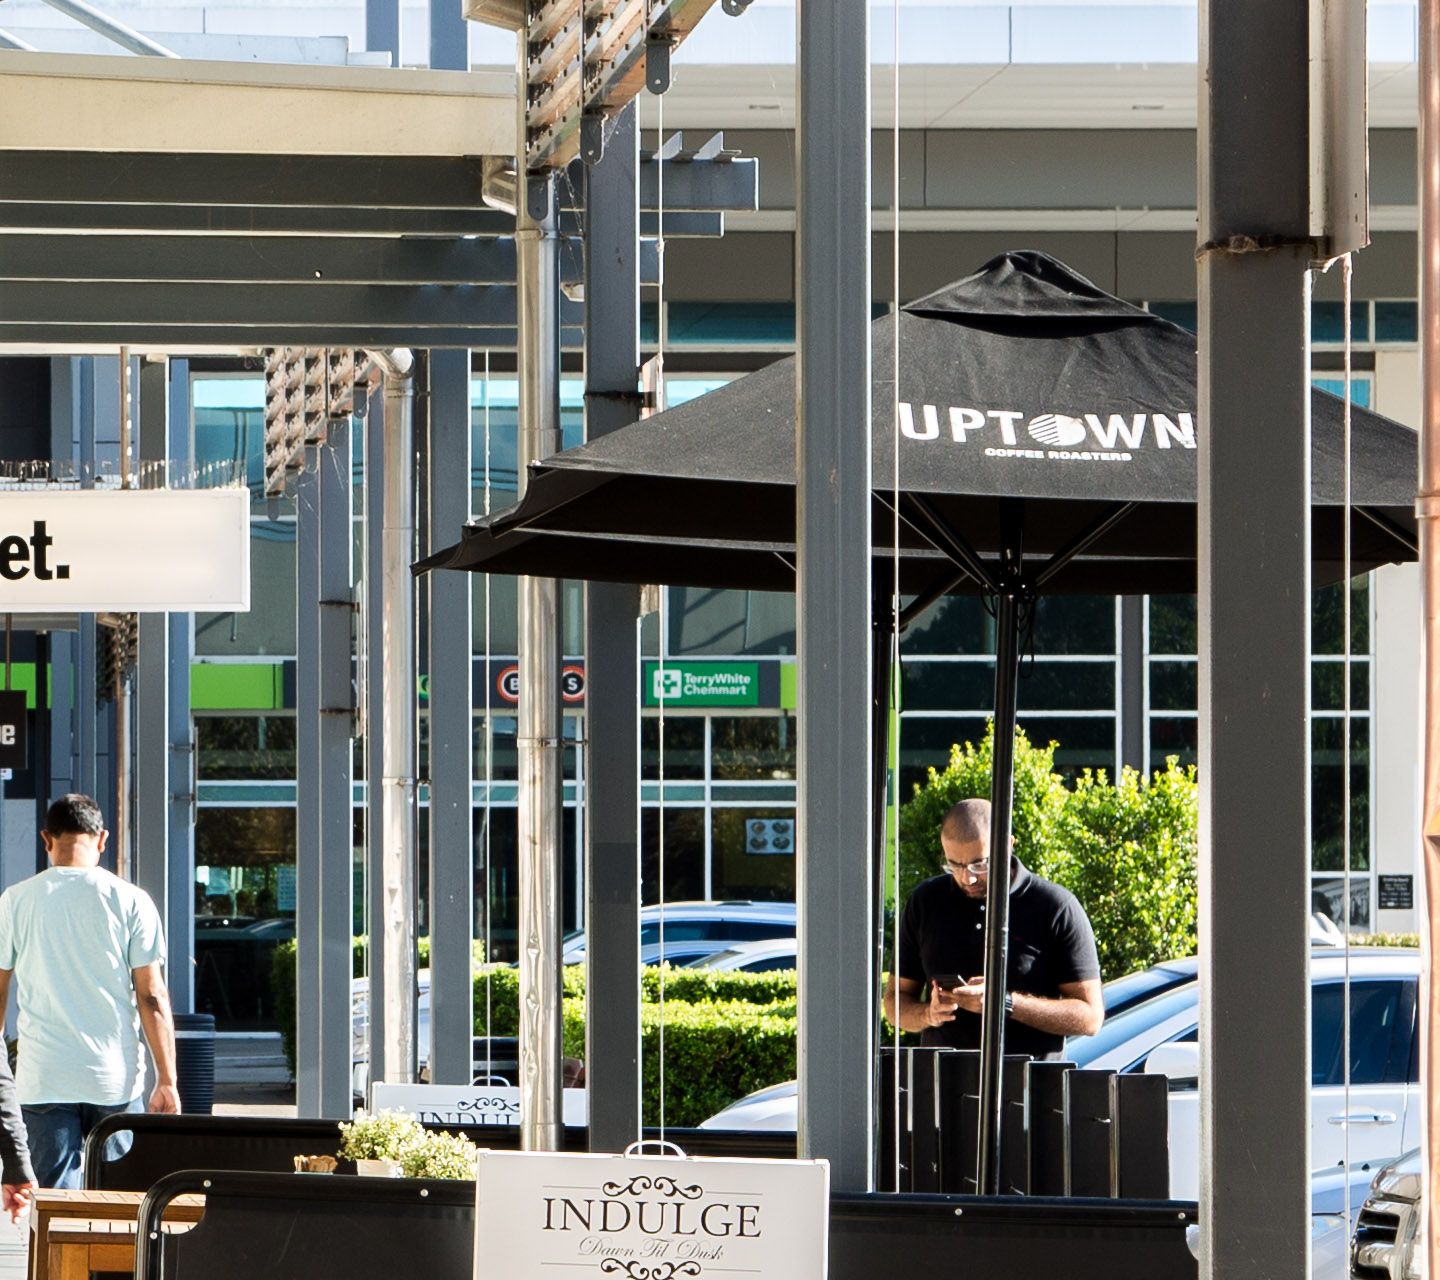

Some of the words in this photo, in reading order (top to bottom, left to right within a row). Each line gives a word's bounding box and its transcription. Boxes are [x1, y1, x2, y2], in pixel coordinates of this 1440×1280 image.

[984, 447, 1044, 459] COFFEE
[1048, 451, 1132, 461] ROASTERS
[683, 672, 752, 686] TerryWhite
[683, 684, 747, 696] Chemmart
[542, 1198, 762, 1238] INDULGE
[578, 1236, 634, 1258] Dawn
[639, 1238, 671, 1258] Til
[674, 1239, 724, 1261] Dusk
